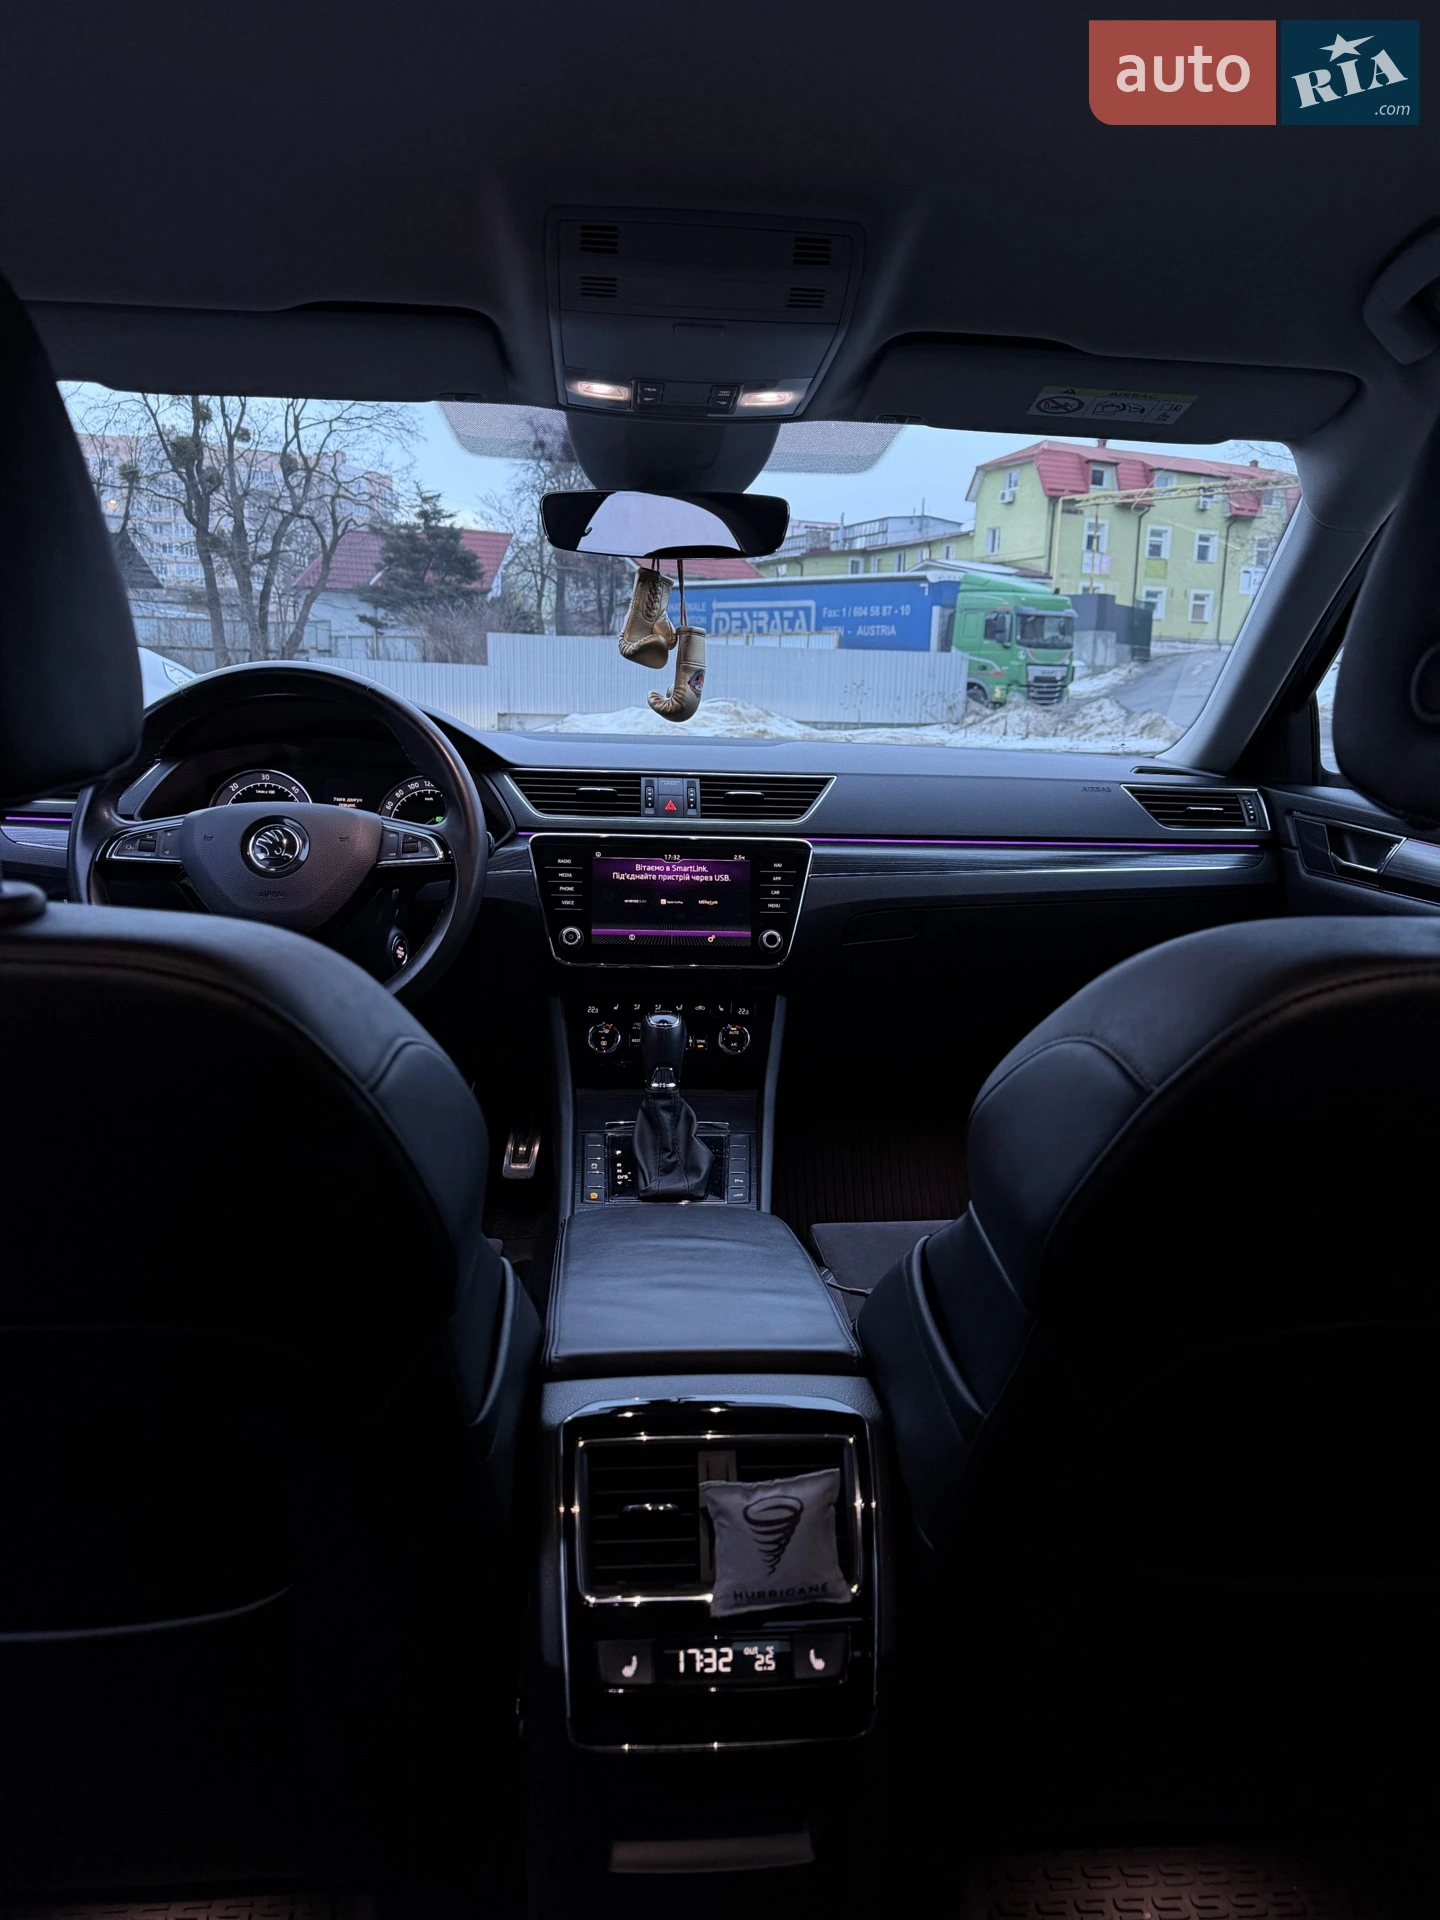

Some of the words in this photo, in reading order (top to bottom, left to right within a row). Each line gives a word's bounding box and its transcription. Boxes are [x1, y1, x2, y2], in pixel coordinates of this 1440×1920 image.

[856, 624, 897, 636] AUSTRIA
[261, 773, 270, 781] 30
[229, 782, 239, 792] 20
[291, 785, 300, 794] 40
[407, 782, 420, 790] 100
[395, 789, 404, 798] 80
[385, 801, 394, 810] 60
[635, 863, 665, 871] Вітаємо
[671, 864, 709, 873] SmartLink.
[612, 871, 657, 881] Під'єднайте
[658, 873, 690, 882] пристрій
[691, 875, 713, 883] через
[714, 874, 732, 882] USB.
[733, 1583, 829, 1600] HURRICANE
[678, 1647, 733, 1673] 17:32
[754, 1654, 776, 1671] 2.5
